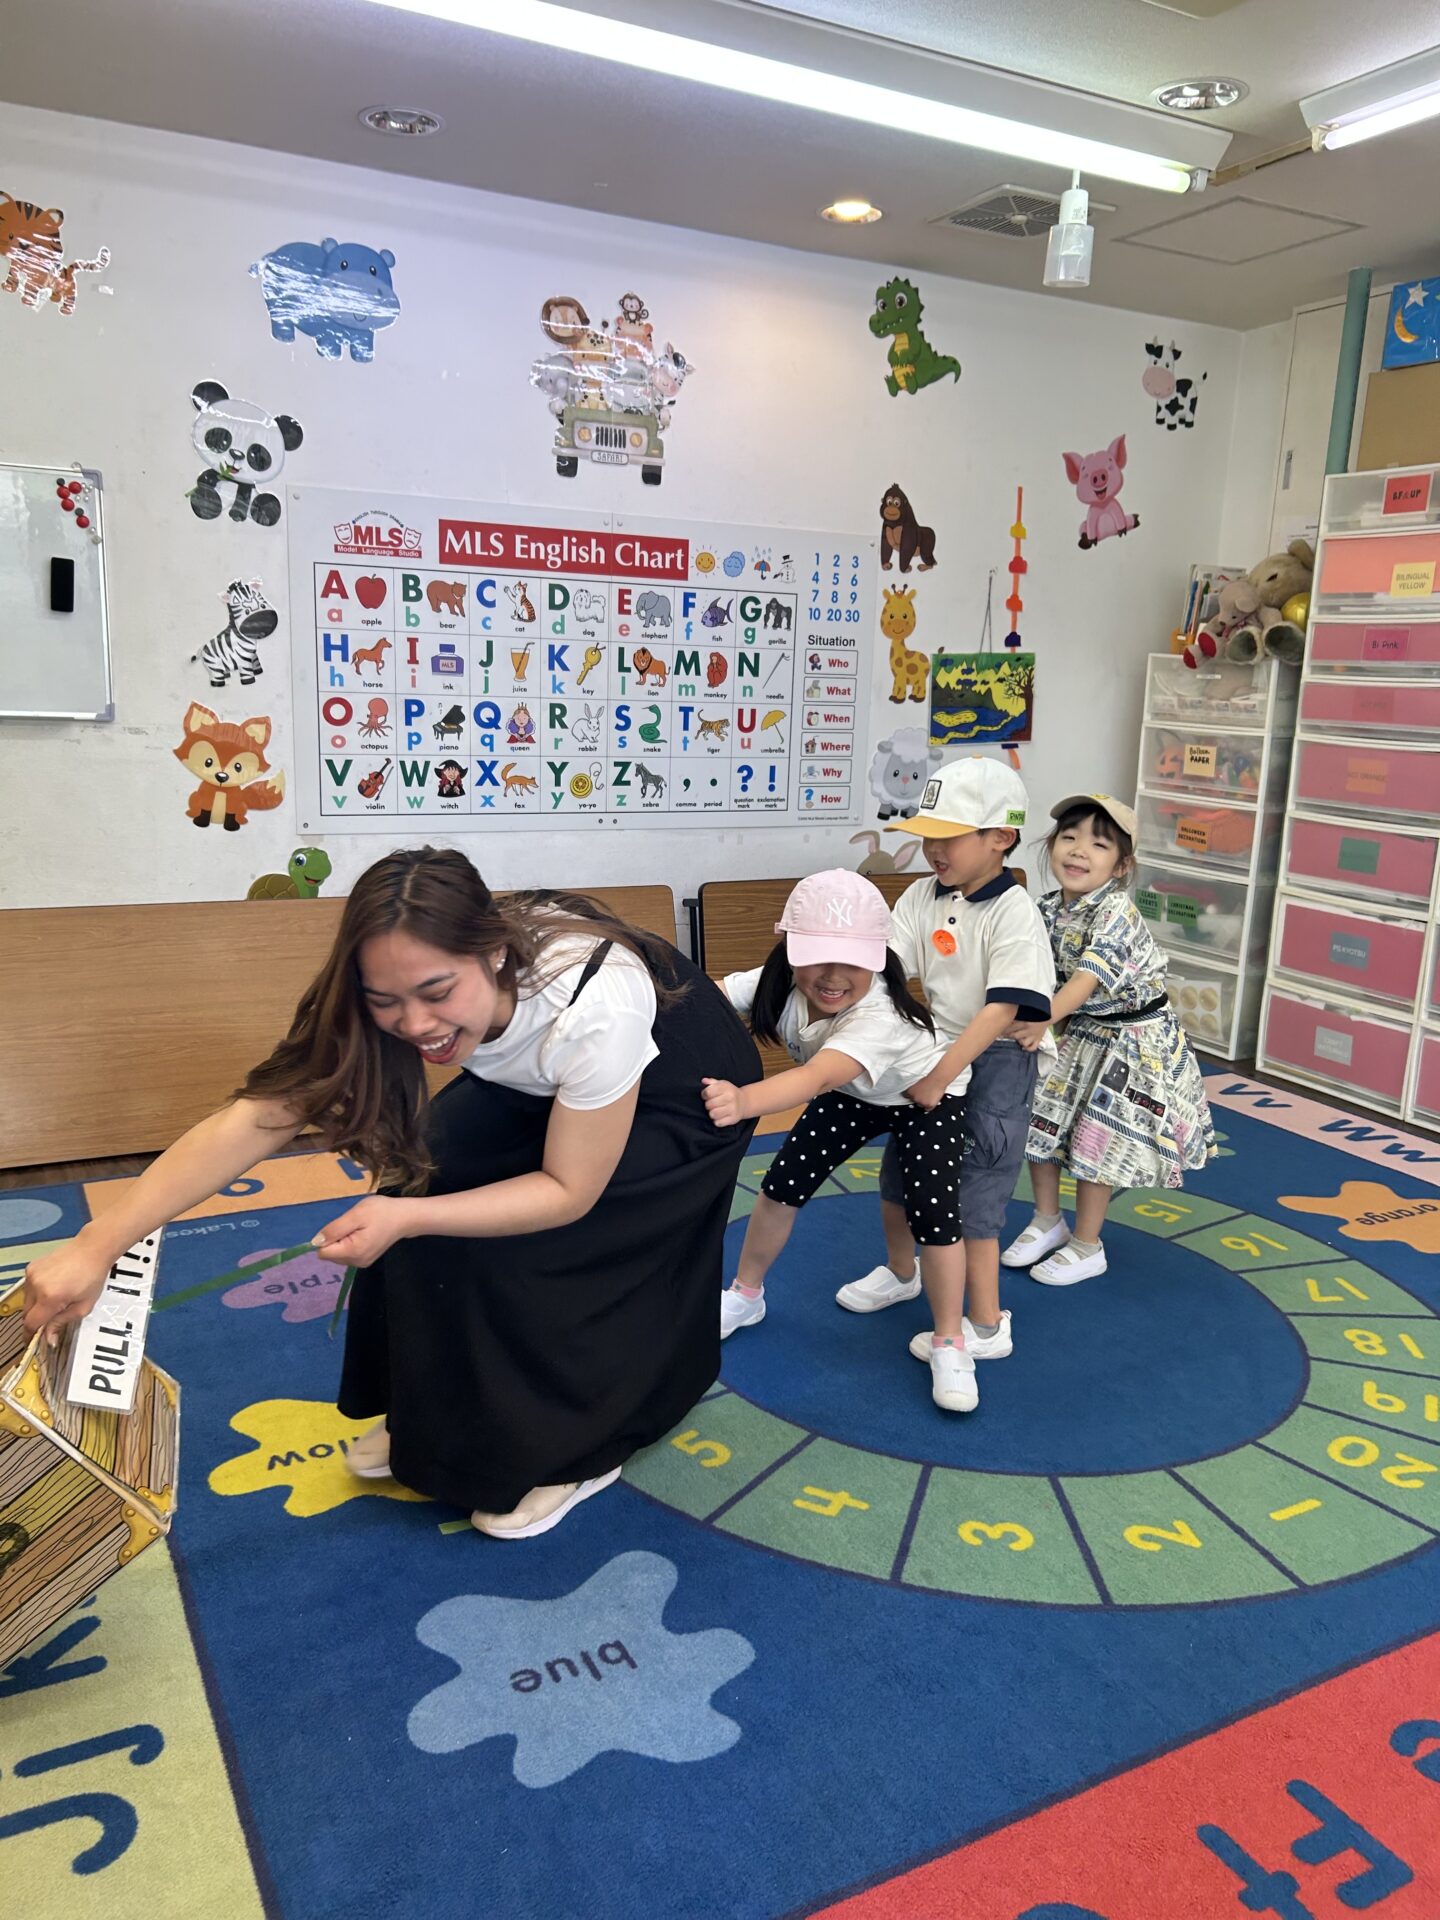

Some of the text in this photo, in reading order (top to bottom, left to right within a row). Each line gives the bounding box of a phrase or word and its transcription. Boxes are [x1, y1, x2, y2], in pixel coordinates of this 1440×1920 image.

[597, 452, 623, 463] SAFARI
[353, 524, 403, 548] MLS
[337, 545, 419, 558] Model Language Studio
[444, 529, 685, 571] MLS English Chart
[815, 553, 859, 568] 1 2 3
[321, 570, 348, 599] A
[402, 574, 422, 601] B
[812, 572, 858, 586] 4 5 6
[1396, 572, 1431, 582] BILINGUAL
[1398, 582, 1426, 590] YELLOW
[476, 579, 496, 608] C
[549, 584, 569, 610] D
[618, 589, 631, 616] E
[683, 592, 696, 617] F
[812, 591, 857, 603] 7 8 9
[328, 608, 342, 622] a
[406, 607, 419, 627] b
[739, 596, 761, 623] G
[808, 608, 860, 622] 10 20 30
[482, 617, 491, 630] c
[552, 615, 565, 634] d
[583, 629, 595, 637] dog
[619, 624, 630, 636] e
[685, 621, 692, 640] f
[744, 627, 756, 644] g
[808, 635, 855, 647] Situation
[323, 634, 348, 662] H
[407, 637, 419, 664] I
[479, 640, 493, 667] J
[549, 645, 570, 671] K
[618, 647, 631, 673] L
[674, 650, 701, 676] M
[738, 652, 759, 677] N
[828, 659, 849, 668] Who
[330, 666, 344, 686] h
[412, 668, 416, 688] i
[483, 670, 489, 694] j
[552, 675, 565, 694] k
[621, 677, 625, 695] l
[678, 684, 695, 696] m
[743, 685, 753, 697] n
[827, 686, 851, 696] What
[323, 697, 353, 726] O
[405, 699, 424, 726] P
[473, 701, 501, 730] Q
[549, 703, 568, 729] R
[615, 705, 631, 731] S
[679, 706, 694, 731] T
[737, 708, 756, 733] U
[824, 714, 850, 723] When
[331, 735, 346, 748] o
[361, 743, 388, 751] octopus
[408, 733, 421, 750] p
[481, 734, 494, 752] q
[554, 738, 562, 749] r
[618, 736, 627, 748] s
[682, 736, 689, 750] t
[741, 738, 751, 749] u
[821, 742, 850, 751] Where
[1190, 755, 1210, 765] PAPER
[325, 759, 353, 786] V
[400, 760, 430, 787] W
[475, 760, 500, 786] X
[547, 762, 569, 786] Y
[612, 761, 631, 786] Z
[822, 768, 842, 778] Why
[332, 796, 347, 808] v
[407, 796, 424, 808] w
[481, 796, 495, 807] x
[552, 792, 564, 809] y
[617, 795, 626, 806] z
[821, 794, 841, 803] How
[1134, 1199, 1192, 1224] 15
[1355, 1203, 1439, 1227] orange
[1220, 1232, 1289, 1257] 16
[1305, 1277, 1370, 1303] 17
[1343, 1328, 1426, 1360] 18
[88, 1322, 134, 1396] PULL
[1363, 1380, 1439, 1423] 19
[670, 1429, 732, 1468] 5
[1326, 1435, 1439, 1489] 20
[792, 1485, 870, 1517] 4
[1268, 1497, 1323, 1522] 1
[957, 1519, 1035, 1552] 3
[1122, 1519, 1202, 1552] 2
[509, 1639, 639, 1694] blue
